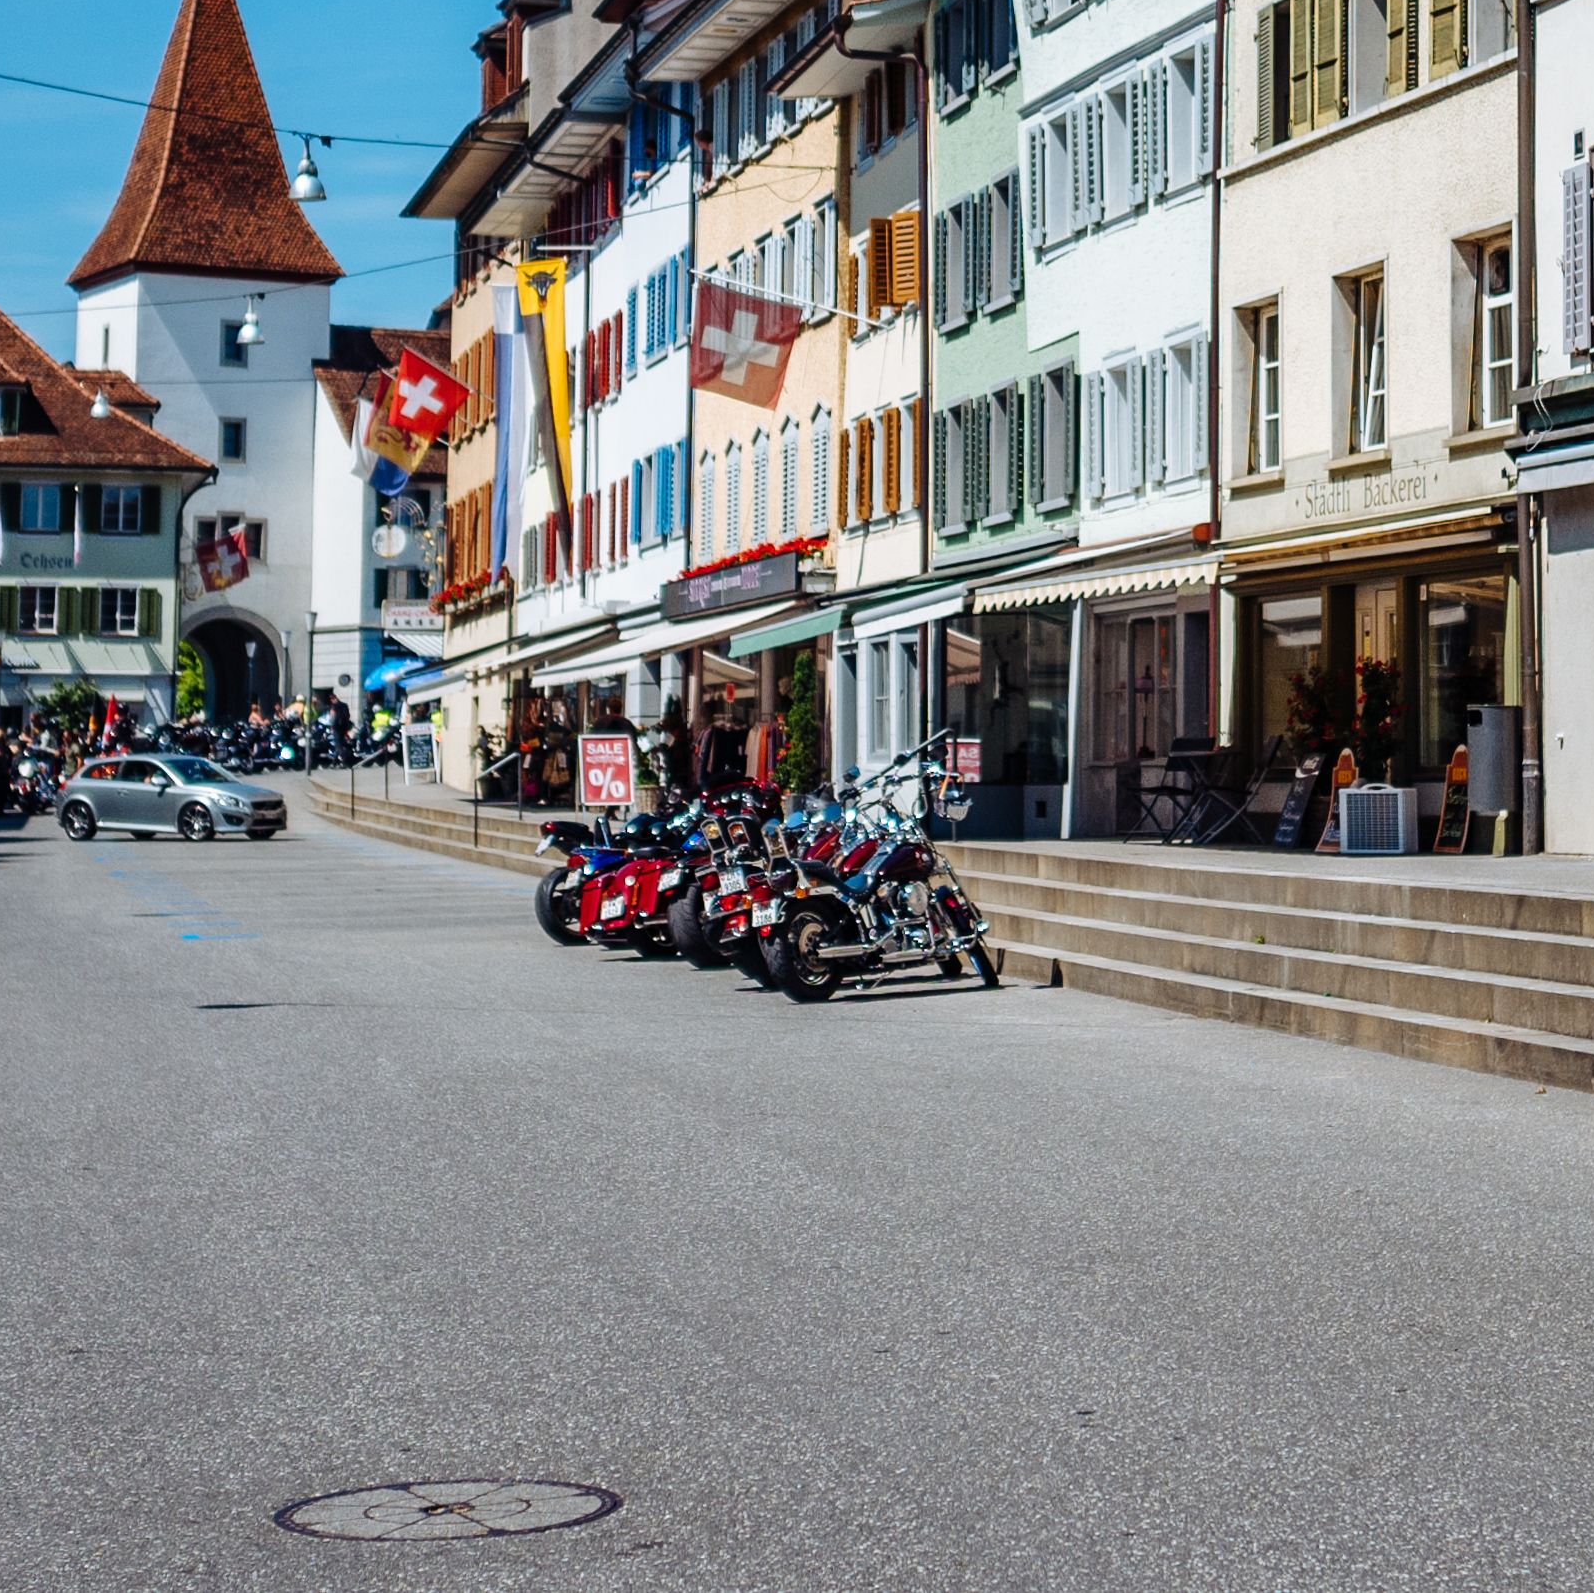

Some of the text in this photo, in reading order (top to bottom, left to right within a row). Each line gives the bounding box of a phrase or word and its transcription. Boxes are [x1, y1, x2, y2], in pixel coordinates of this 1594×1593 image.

[1305, 464, 1427, 518] Städtli Bäckerei
[587, 743, 624, 755] SALE
[588, 767, 625, 801] %
